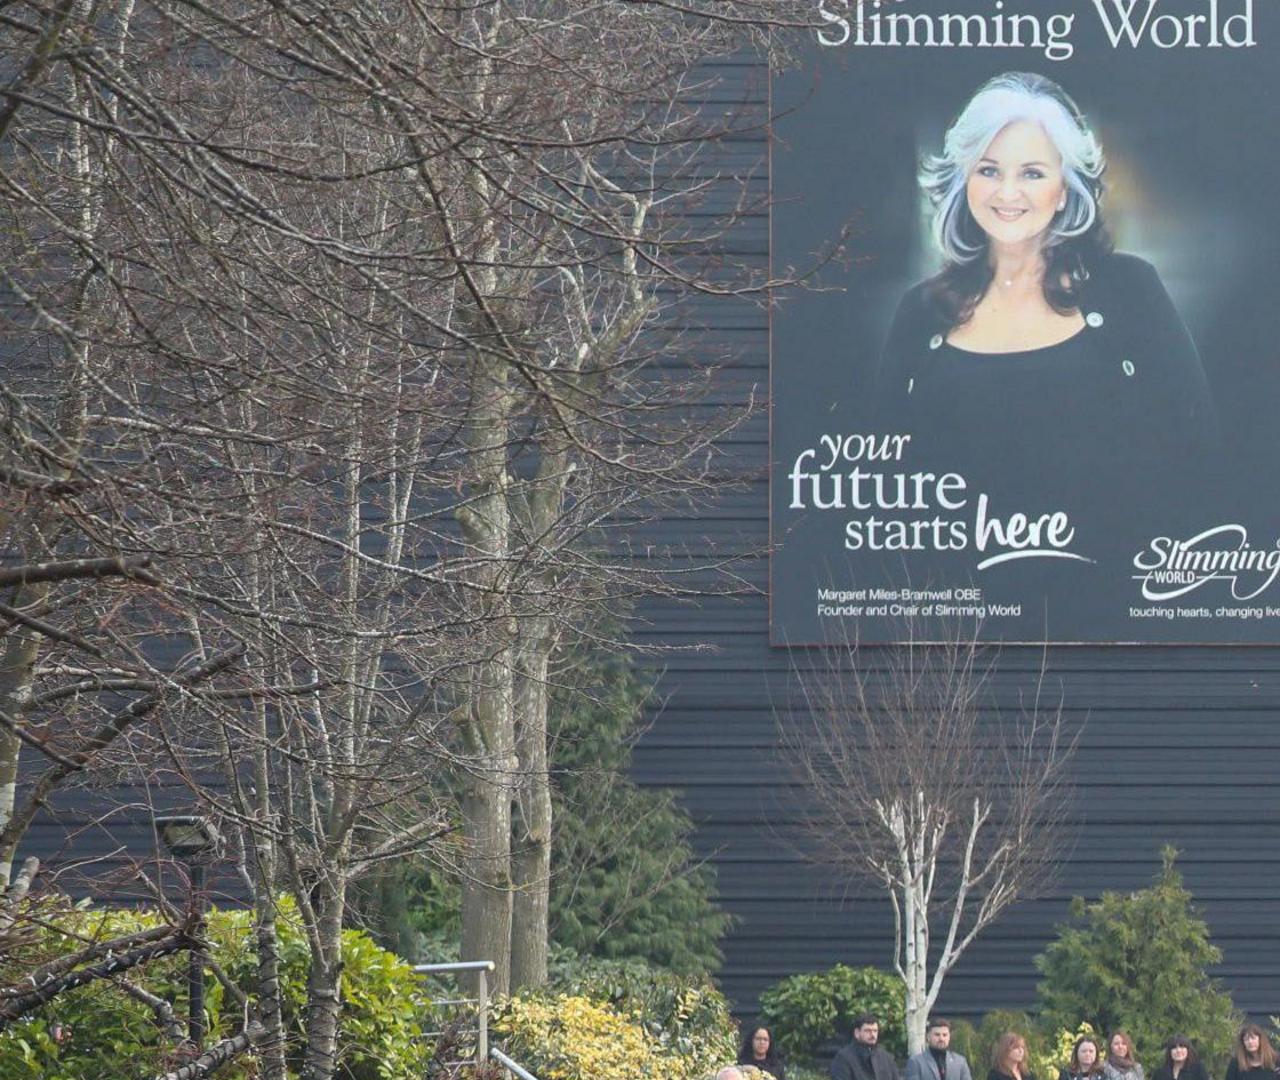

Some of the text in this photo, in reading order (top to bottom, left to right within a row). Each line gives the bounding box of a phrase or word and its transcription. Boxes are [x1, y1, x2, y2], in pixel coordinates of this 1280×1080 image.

[817, 0, 1257, 60] Slimming World
[820, 434, 911, 470] your
[788, 449, 967, 509] future
[845, 493, 1075, 551] starts here
[1155, 571, 1196, 584] WORLD
[817, 588, 981, 602] Margaret Miles-Bramwell OBE
[817, 604, 1021, 618] Founder and Chair of Slimming World
[1129, 606, 1174, 619] touching
[1176, 606, 1213, 618] hearts,
[1216, 606, 1263, 619] changing
